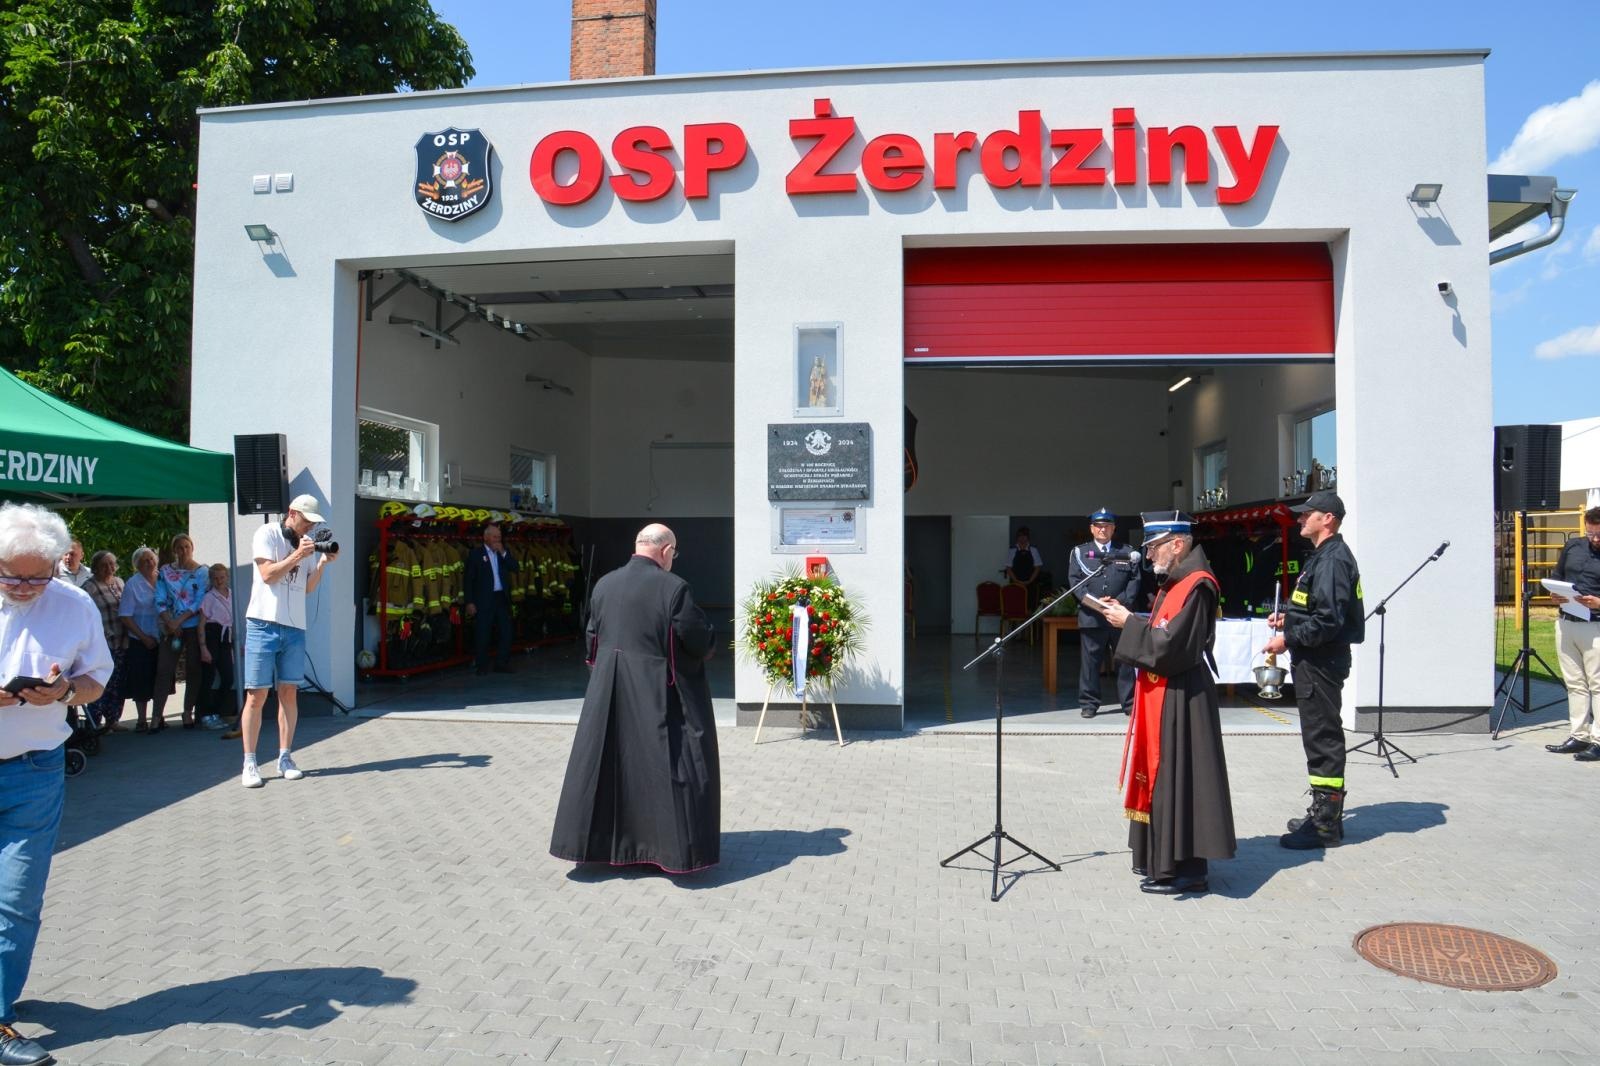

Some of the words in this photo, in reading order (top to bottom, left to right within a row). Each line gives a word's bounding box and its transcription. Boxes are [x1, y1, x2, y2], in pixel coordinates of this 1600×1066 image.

[433, 132, 471, 147] OSP
[529, 122, 748, 206] OSP
[785, 98, 1280, 206] Żerdziny
[421, 194, 479, 215] ŻERDZINY
